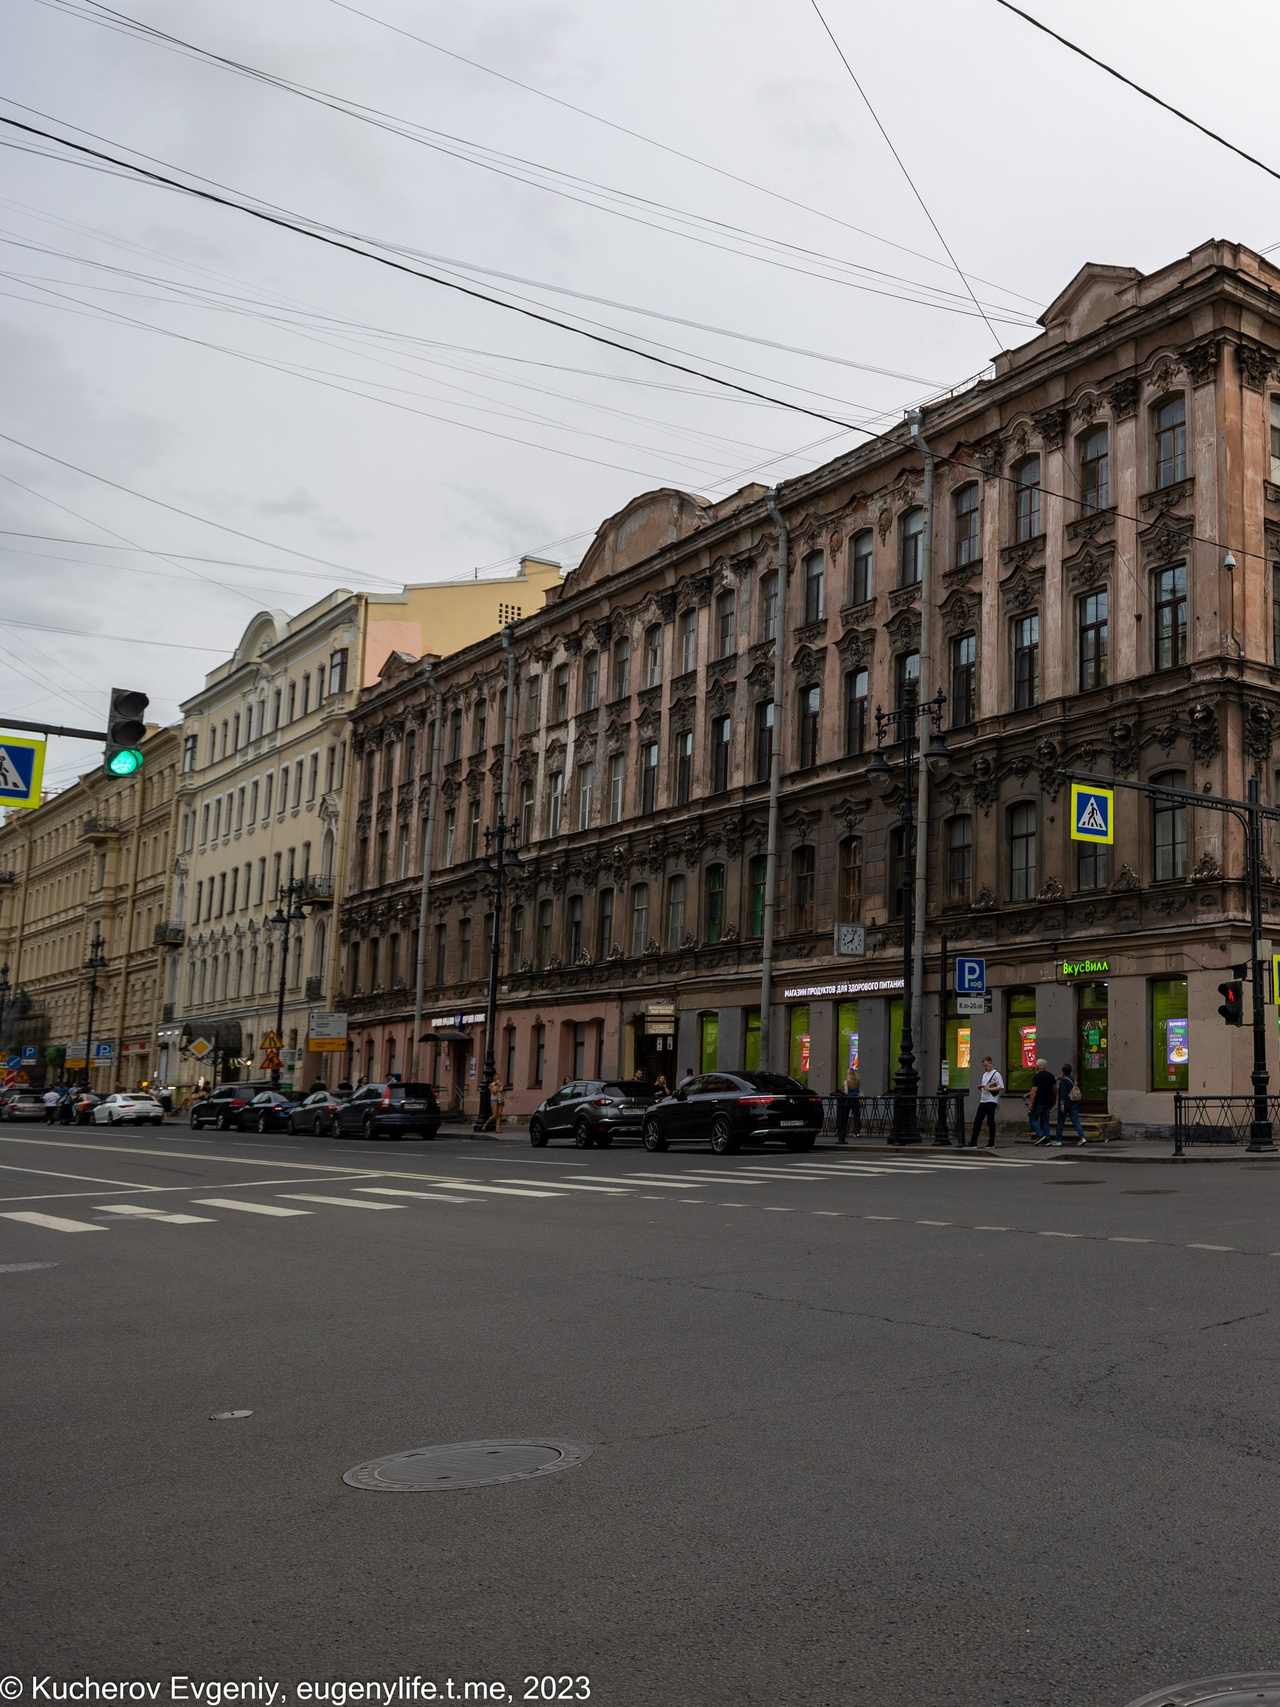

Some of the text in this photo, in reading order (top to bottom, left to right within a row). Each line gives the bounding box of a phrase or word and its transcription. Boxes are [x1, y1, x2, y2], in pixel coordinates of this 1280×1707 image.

[964, 962, 980, 989] P
[1063, 960, 1108, 975] ВкусВилл
[784, 987, 807, 997] МАГАЗИН
[807, 985, 836, 996] ПРОДУКТОВ
[836, 984, 848, 994] ДЛЯ
[848, 981, 879, 993] ЗДОРОВОГО
[879, 979, 904, 990] ПИТАНИЯ
